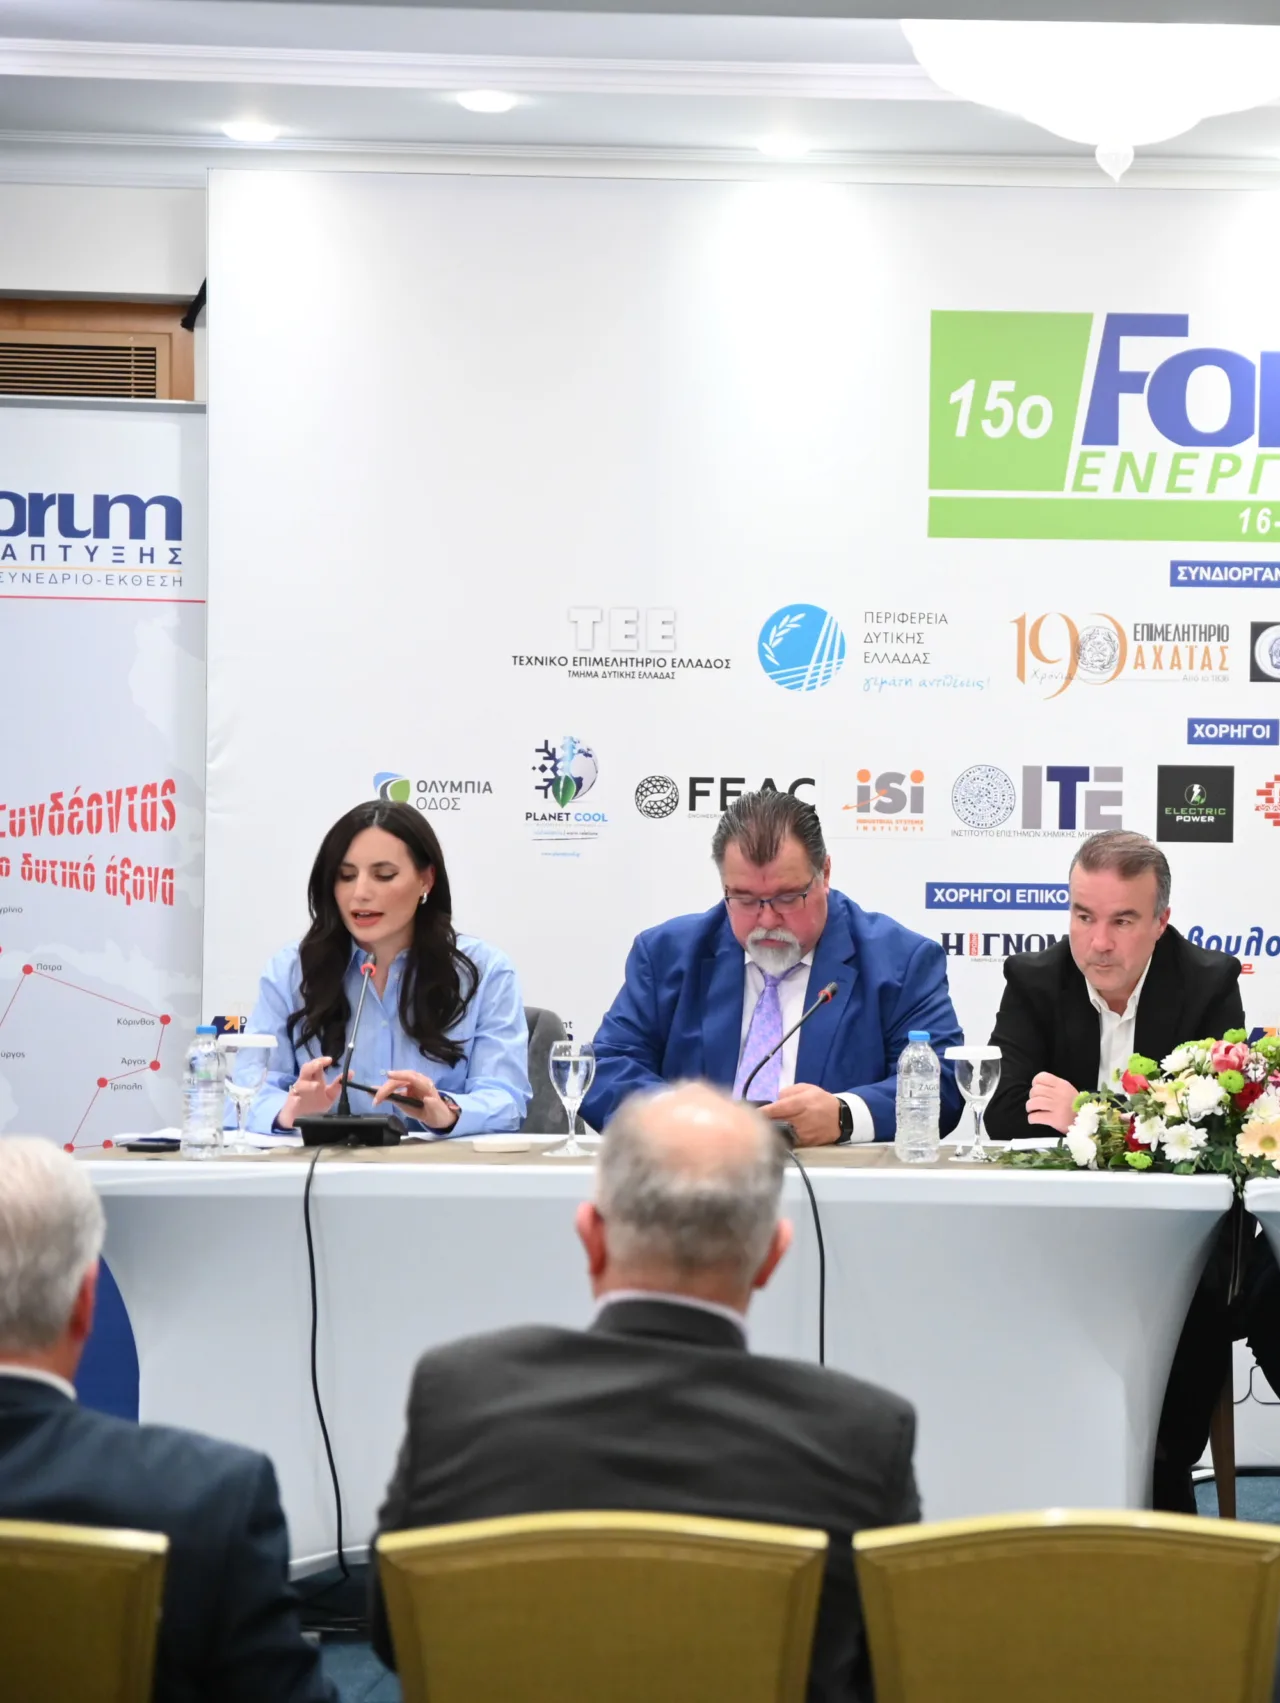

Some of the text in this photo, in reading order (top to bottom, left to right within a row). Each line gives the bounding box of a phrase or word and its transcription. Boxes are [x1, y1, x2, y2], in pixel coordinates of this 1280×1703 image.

[0, 491, 182, 541] orum
[1, 543, 182, 565] ΑΠΤΥΞΗΣ
[863, 611, 949, 625] ΠΕΡΙΦΕΡΕΙΑ
[567, 606, 677, 652] ΤΕΕ
[1133, 623, 1230, 643] ΕΠΙΜΕΛΗΤΗΡΙΟ
[863, 631, 925, 645] ΔΥΤΙΚΗΣ
[511, 655, 731, 669] ΤΕΧΝΙΚΟ ΕΠΙΜΕΛΗΤΗΡΙΟ ΕΛΛΑΔΟΣ
[863, 652, 931, 665] ΕΛΛΑΔΑΣ
[1133, 644, 1229, 671] ΑΧΑΪΑΣ
[568, 669, 676, 680] ΤΜΗΜΑ ΔΥΤΙΚΗΣ ΕΛΛΑΔΑΣ
[1193, 723, 1271, 739] ΧΟΡΗΓΟΙ
[416, 780, 493, 794] ΟΛΥΜΠΙΑ
[416, 796, 461, 811] ΟΔΟΣ
[1021, 765, 1123, 831] ΙΤΕ
[525, 812, 608, 822] PLANET COOL
[1164, 807, 1227, 816] ELECTRIC
[1175, 815, 1215, 823] POWER
[951, 829, 994, 837] ΙΝΣΤΙΤΟΥΤΟ
[996, 830, 1041, 838] ΕΠΙΣΤΗΜΩΝ
[21, 853, 96, 893] δυτικό
[105, 855, 175, 906] άξονα
[933, 887, 1011, 903] ΧΟΡΗΓΟΙ
[116, 1017, 156, 1027] Κόρινθος
